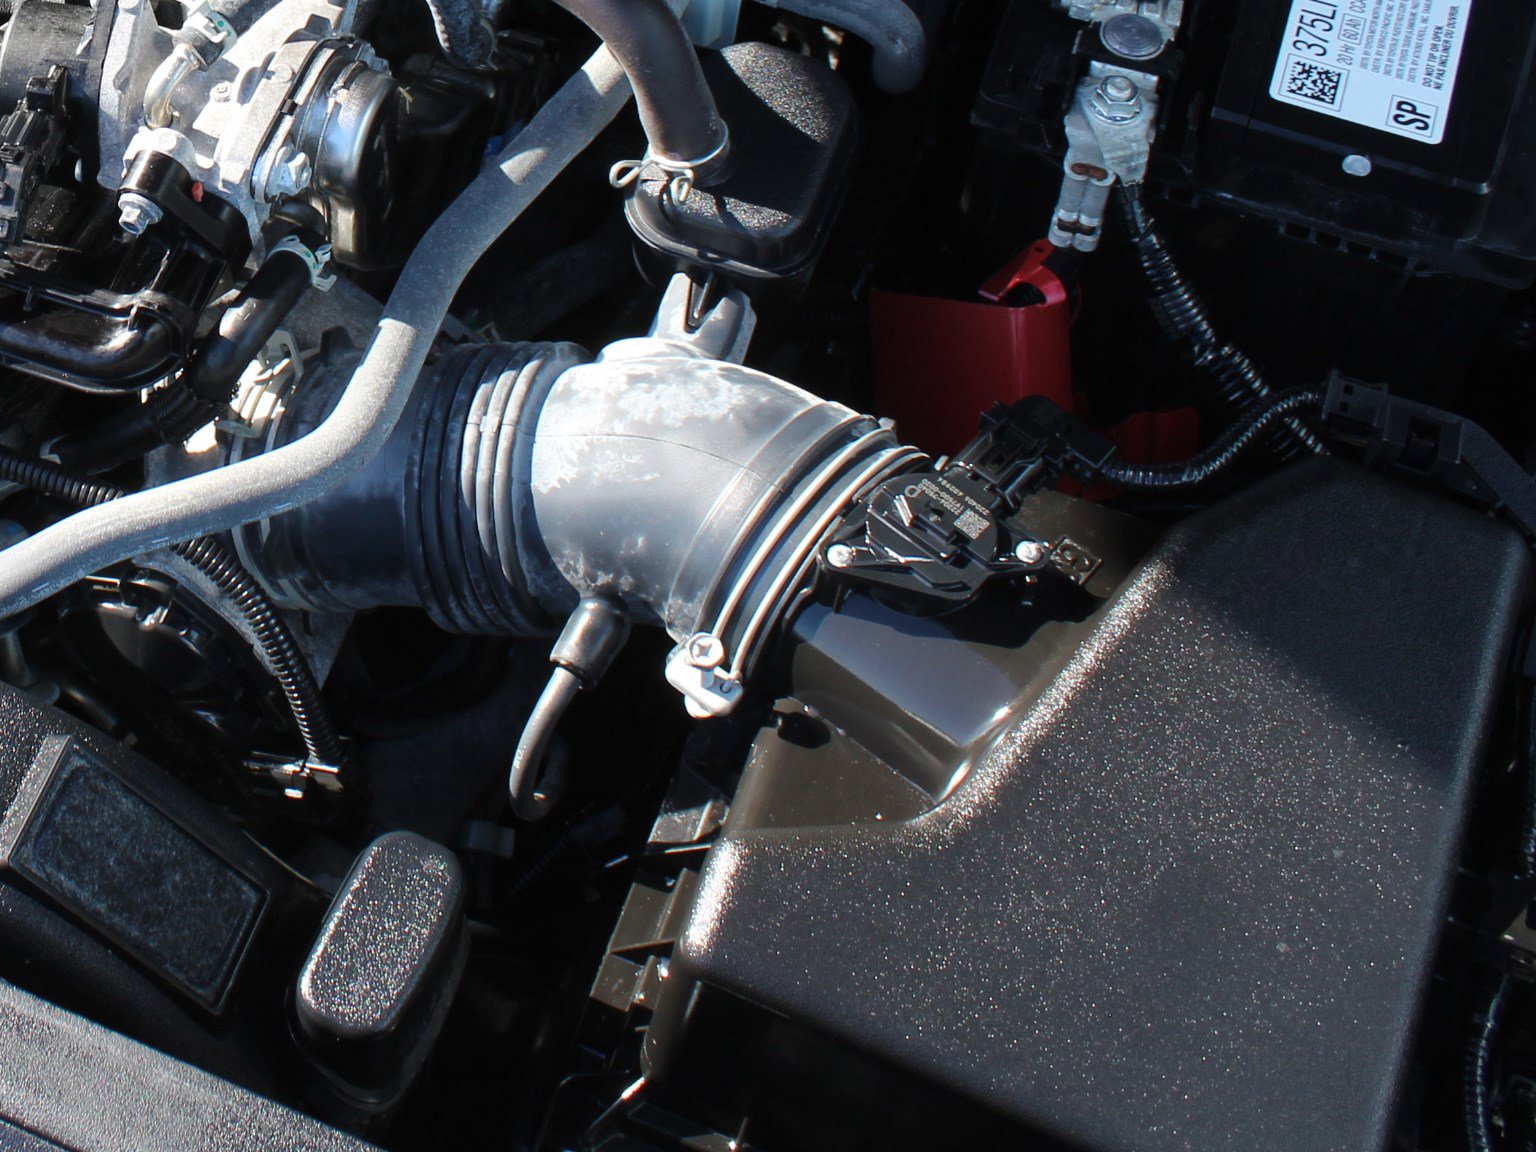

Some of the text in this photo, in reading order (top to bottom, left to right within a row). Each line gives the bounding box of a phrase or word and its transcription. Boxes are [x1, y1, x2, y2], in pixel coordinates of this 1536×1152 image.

[1345, 19, 1361, 30] Ah
[1342, 29, 1359, 40] 60
[1336, 54, 1353, 66] 20
[1427, 53, 1437, 62] TIP
[1425, 64, 1435, 77] NOT
[1435, 68, 1446, 81] PAS
[1393, 101, 1430, 130] SP
